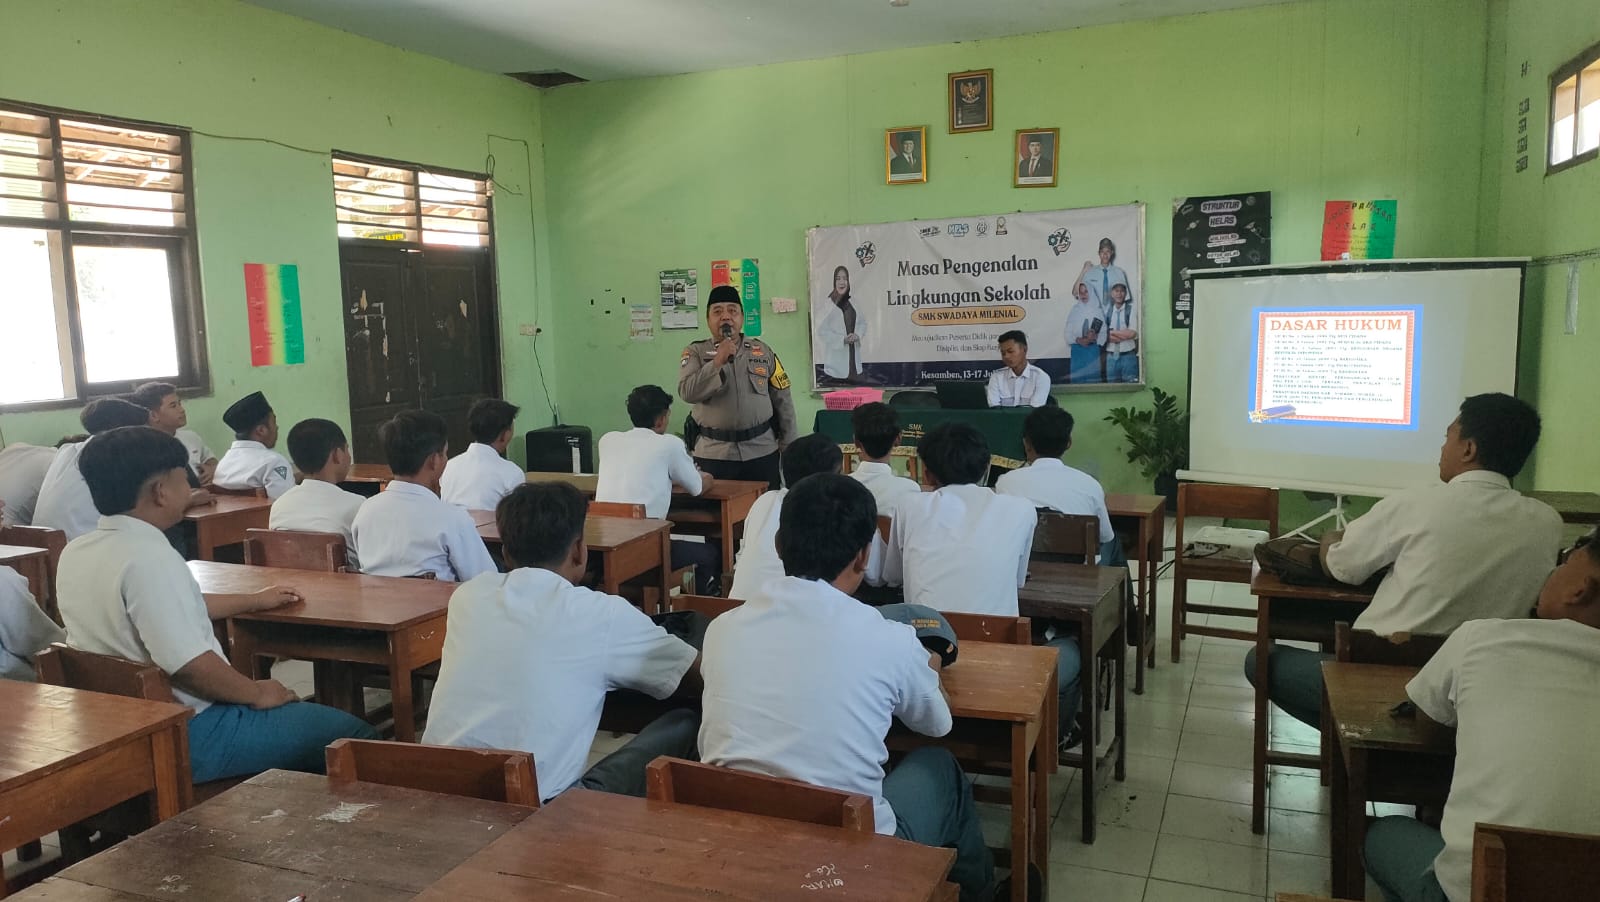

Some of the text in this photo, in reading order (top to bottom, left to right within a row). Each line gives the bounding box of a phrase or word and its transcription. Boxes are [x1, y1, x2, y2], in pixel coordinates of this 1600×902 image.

[1202, 201, 1240, 211] STRUKTUR
[1210, 216, 1235, 226] KELAS
[897, 254, 1039, 277] Masa Pengenalan
[887, 282, 1051, 308] Lingkungan Sekolah
[918, 309, 1019, 321] SMK SWADAYA MILENIAL
[1270, 319, 1402, 331] DASAR HUKUM
[921, 370, 963, 379] Kesamben,
[963, 369, 983, 379] 13-17
